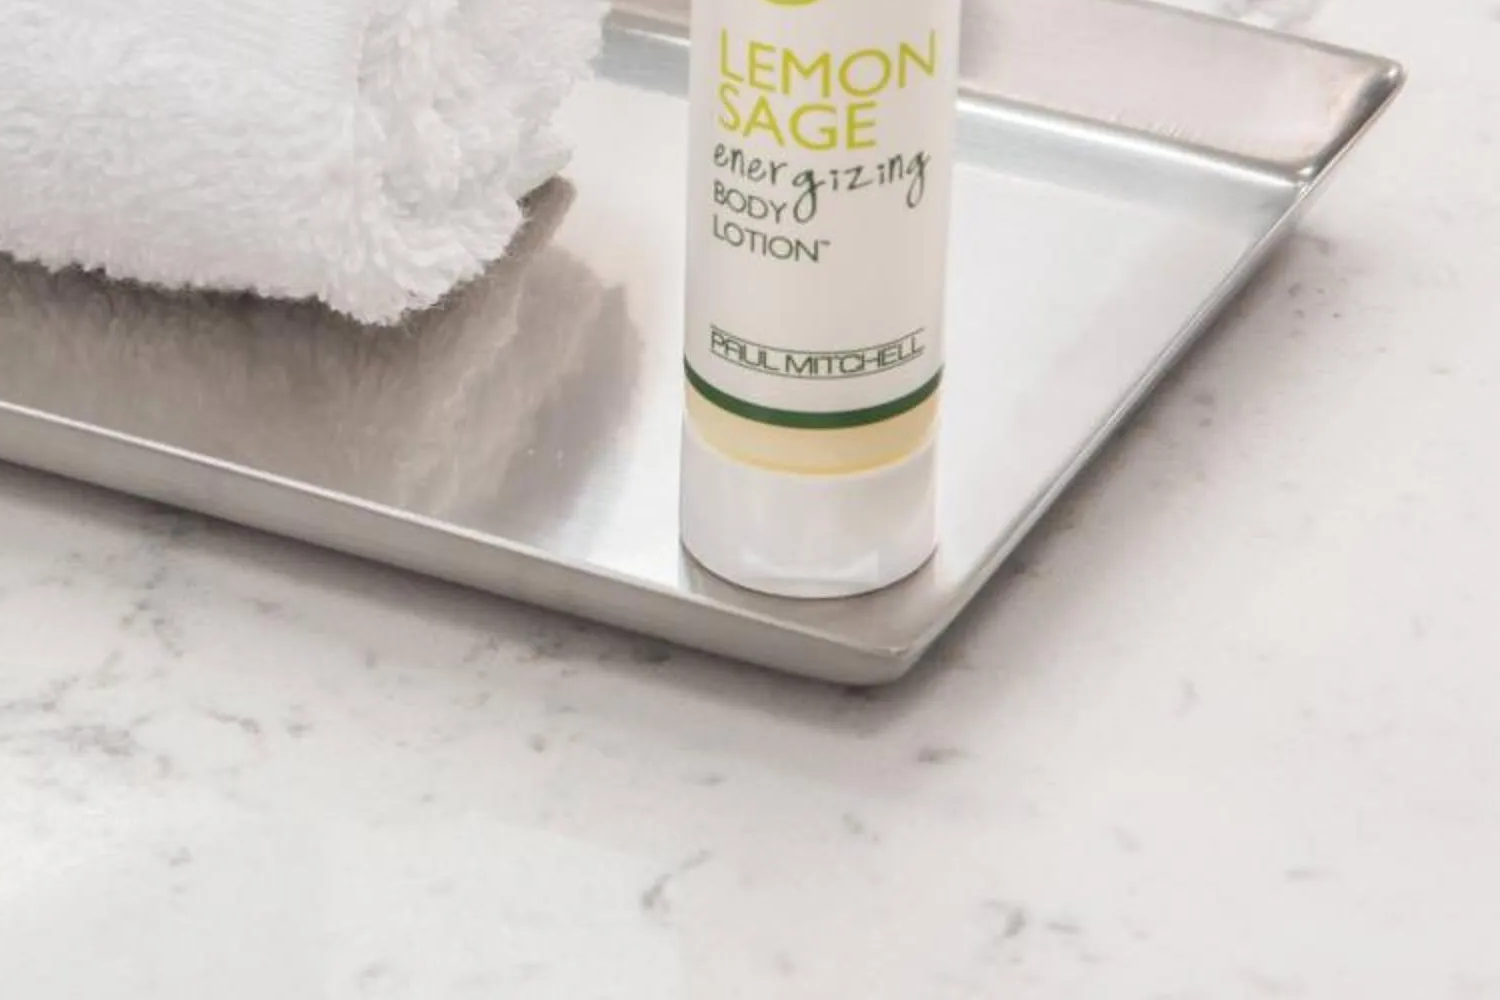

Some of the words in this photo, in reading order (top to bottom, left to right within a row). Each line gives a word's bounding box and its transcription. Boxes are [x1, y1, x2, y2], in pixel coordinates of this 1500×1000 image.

[719, 28, 938, 99] LEMON
[718, 82, 877, 150] SAGE
[713, 142, 930, 224] energizing
[713, 179, 787, 224] BODY
[710, 329, 780, 371] PAUL
[784, 337, 925, 376] MITCHELL
